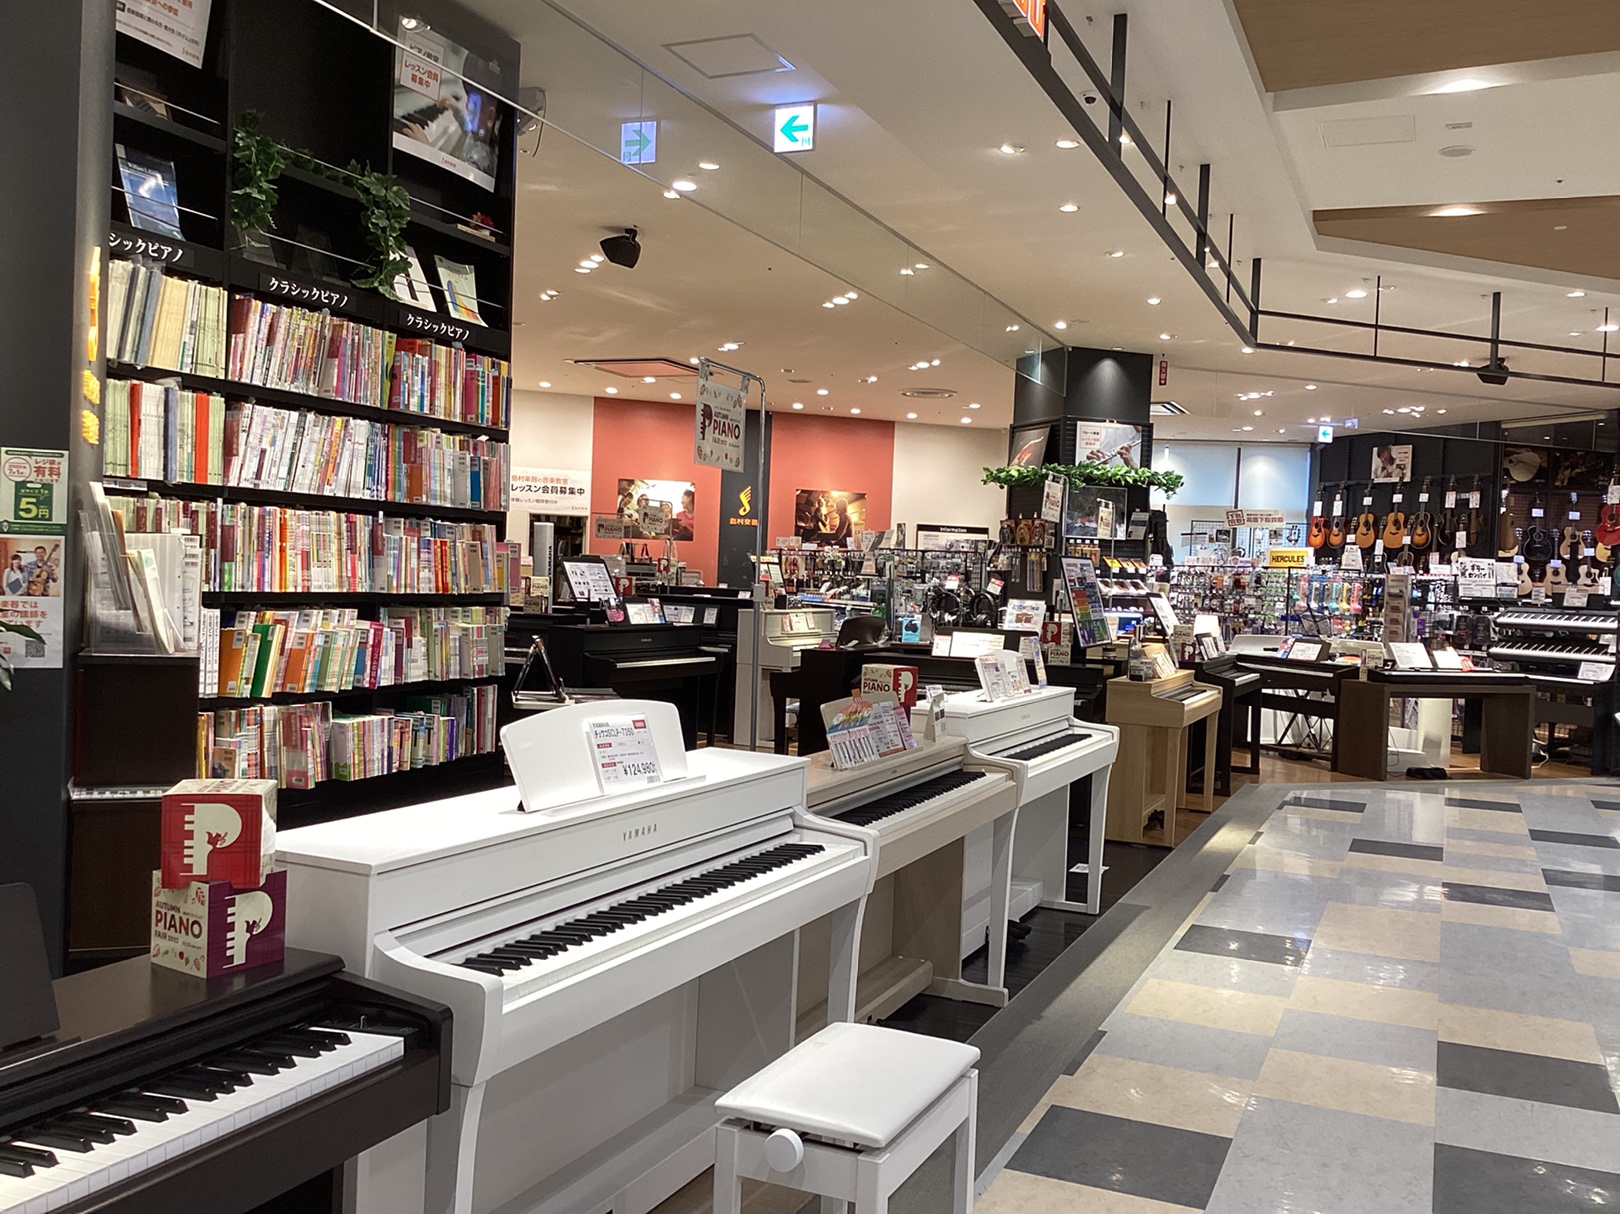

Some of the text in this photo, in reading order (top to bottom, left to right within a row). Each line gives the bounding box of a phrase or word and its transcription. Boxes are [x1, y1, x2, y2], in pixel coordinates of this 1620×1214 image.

[404, 59, 440, 82] レッスン会員
[410, 74, 431, 89] 募集中
[268, 276, 348, 308] クラシックピアノ
[406, 312, 470, 341] クラシックピアノ
[713, 419, 741, 440] PIANO
[34, 465, 62, 478] 有料
[512, 474, 569, 485] 島村楽器の音楽教室
[511, 484, 585, 496] レッスン会員募集中
[18, 497, 49, 519] 5円
[1271, 554, 1305, 563] HERCULES
[863, 682, 890, 692] PIANO
[623, 824, 658, 841] YAMAHA
[156, 900, 181, 913] AUTUMN
[155, 909, 203, 939] PIANO
[154, 930, 167, 940] FAIR
